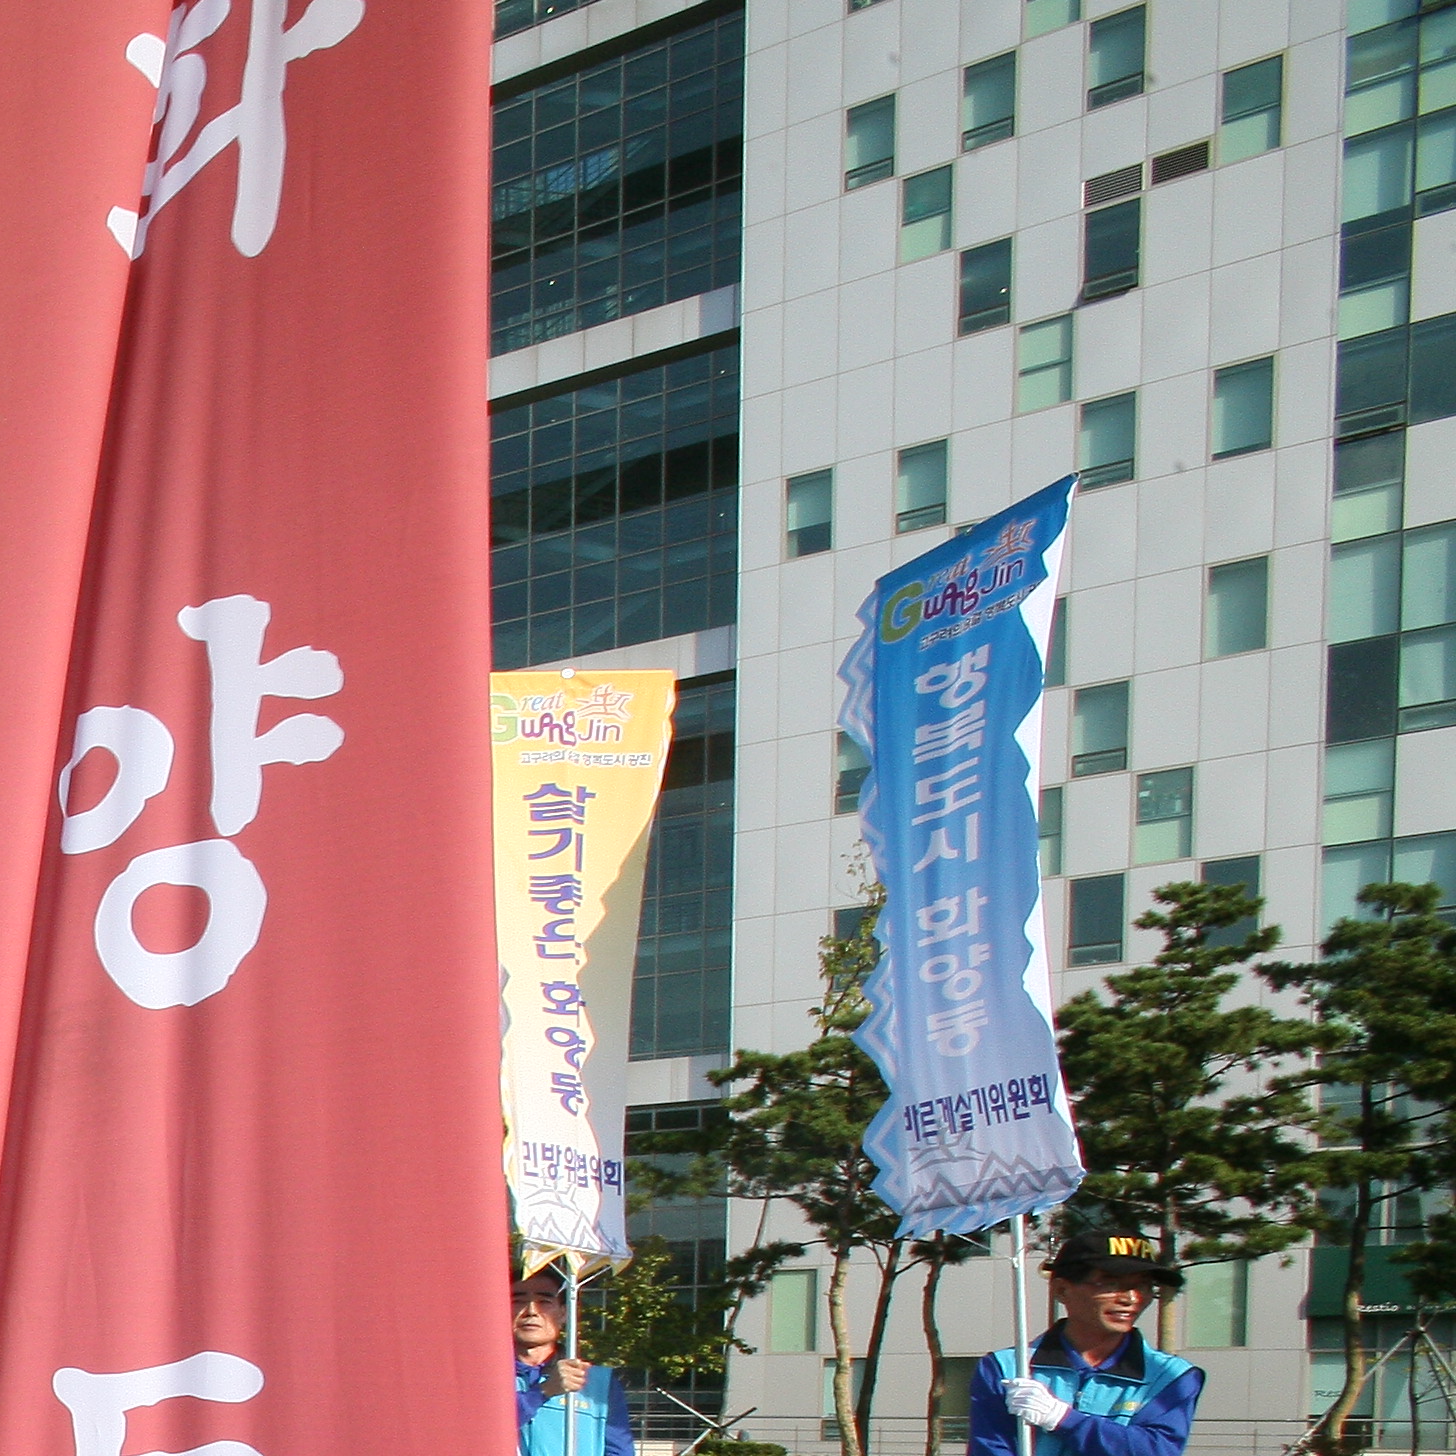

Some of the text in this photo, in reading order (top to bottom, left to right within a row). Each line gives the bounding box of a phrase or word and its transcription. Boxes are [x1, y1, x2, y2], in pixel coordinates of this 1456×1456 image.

[911, 643, 992, 874] 행복도시
[522, 782, 597, 964] 살기좋은
[916, 886, 990, 1058] 화양동
[903, 1072, 1054, 1143] 바르게살기위원회
